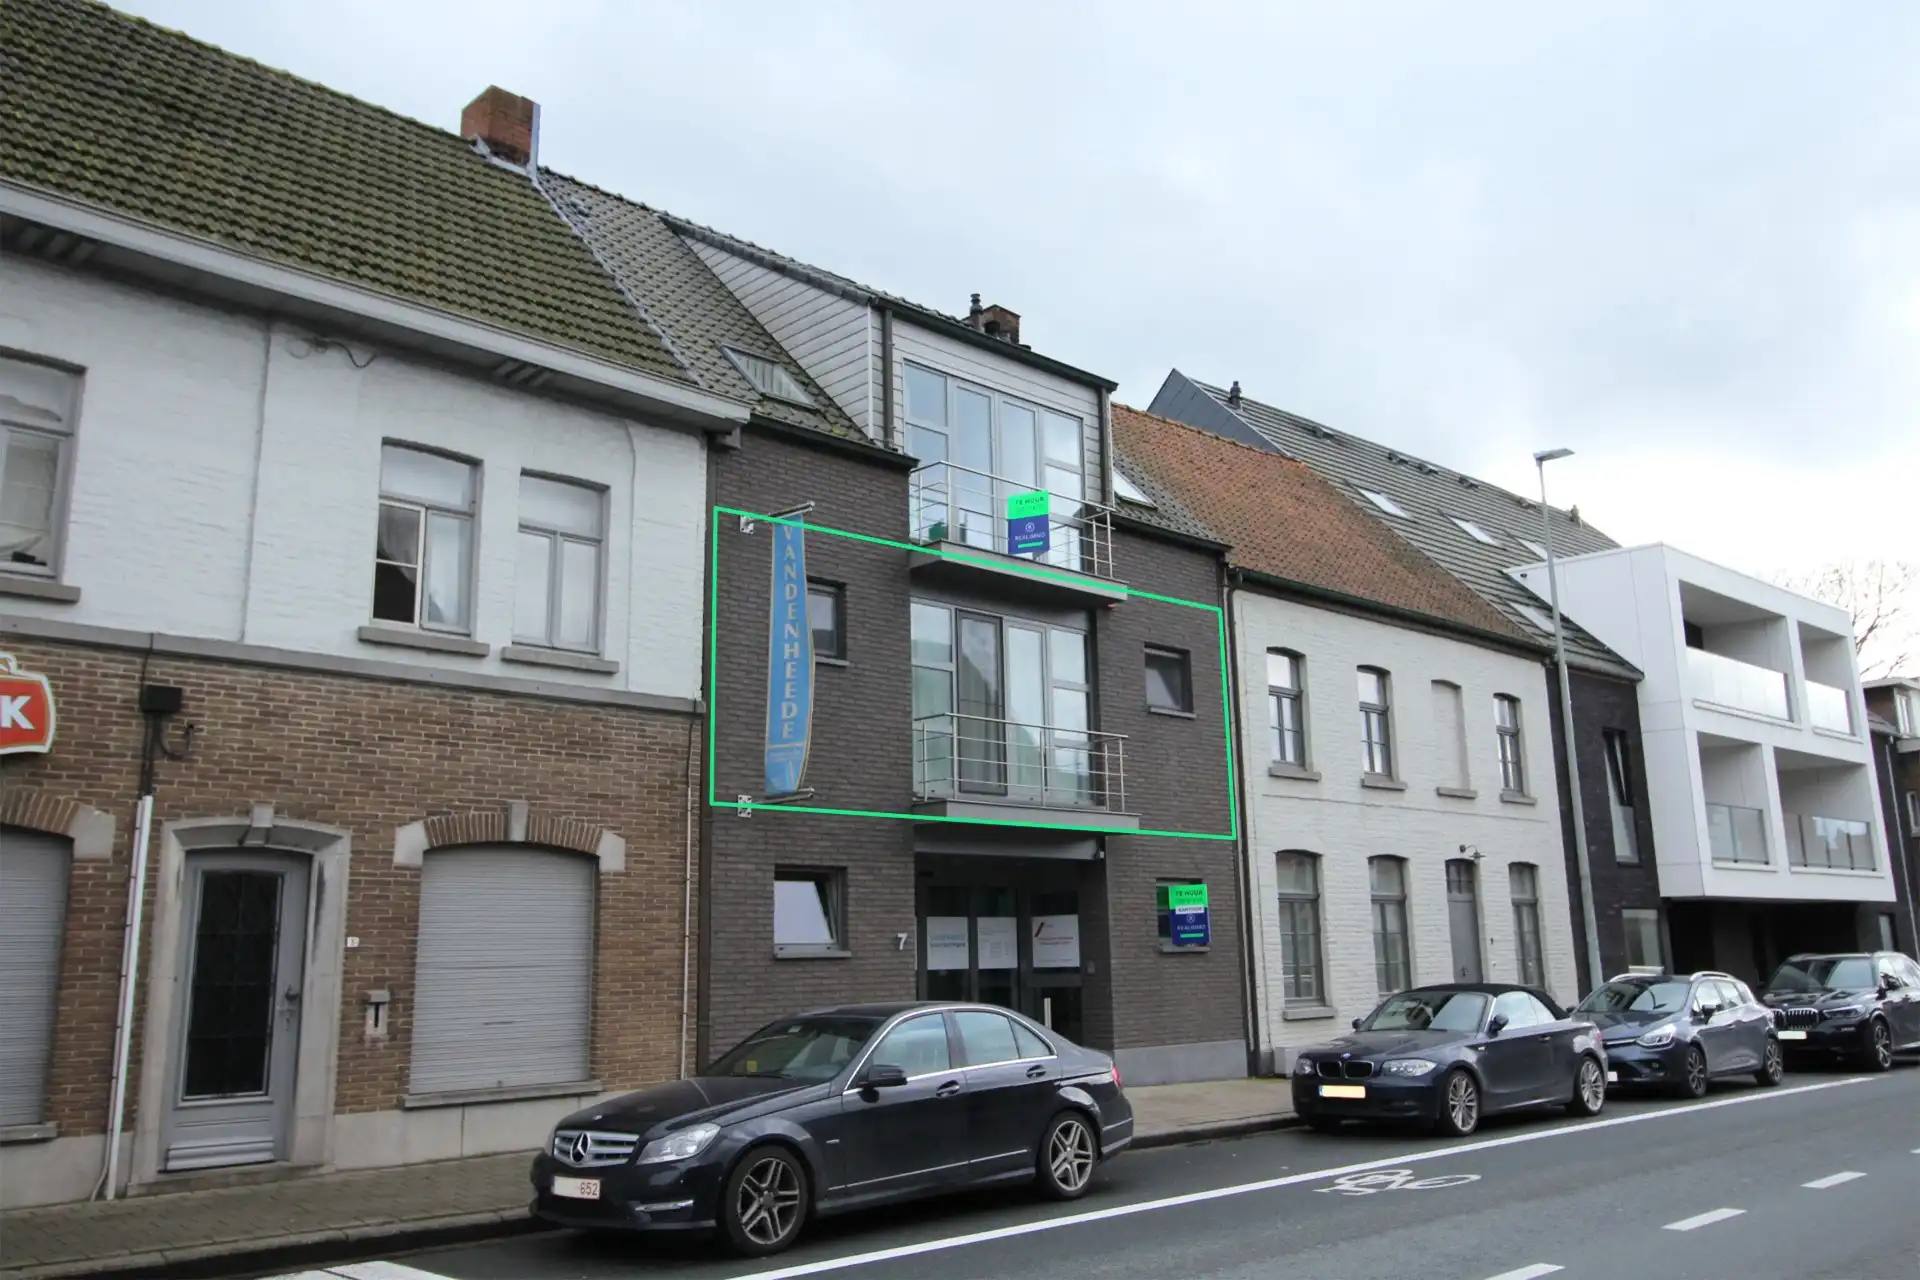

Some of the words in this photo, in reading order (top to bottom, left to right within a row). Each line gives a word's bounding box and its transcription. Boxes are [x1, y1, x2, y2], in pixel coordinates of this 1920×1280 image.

[781, 525, 799, 739] VANDENHEEDE
[1184, 889, 1203, 897] HUUR
[896, 932, 908, 950] 7
[580, 1182, 598, 1196] 652
